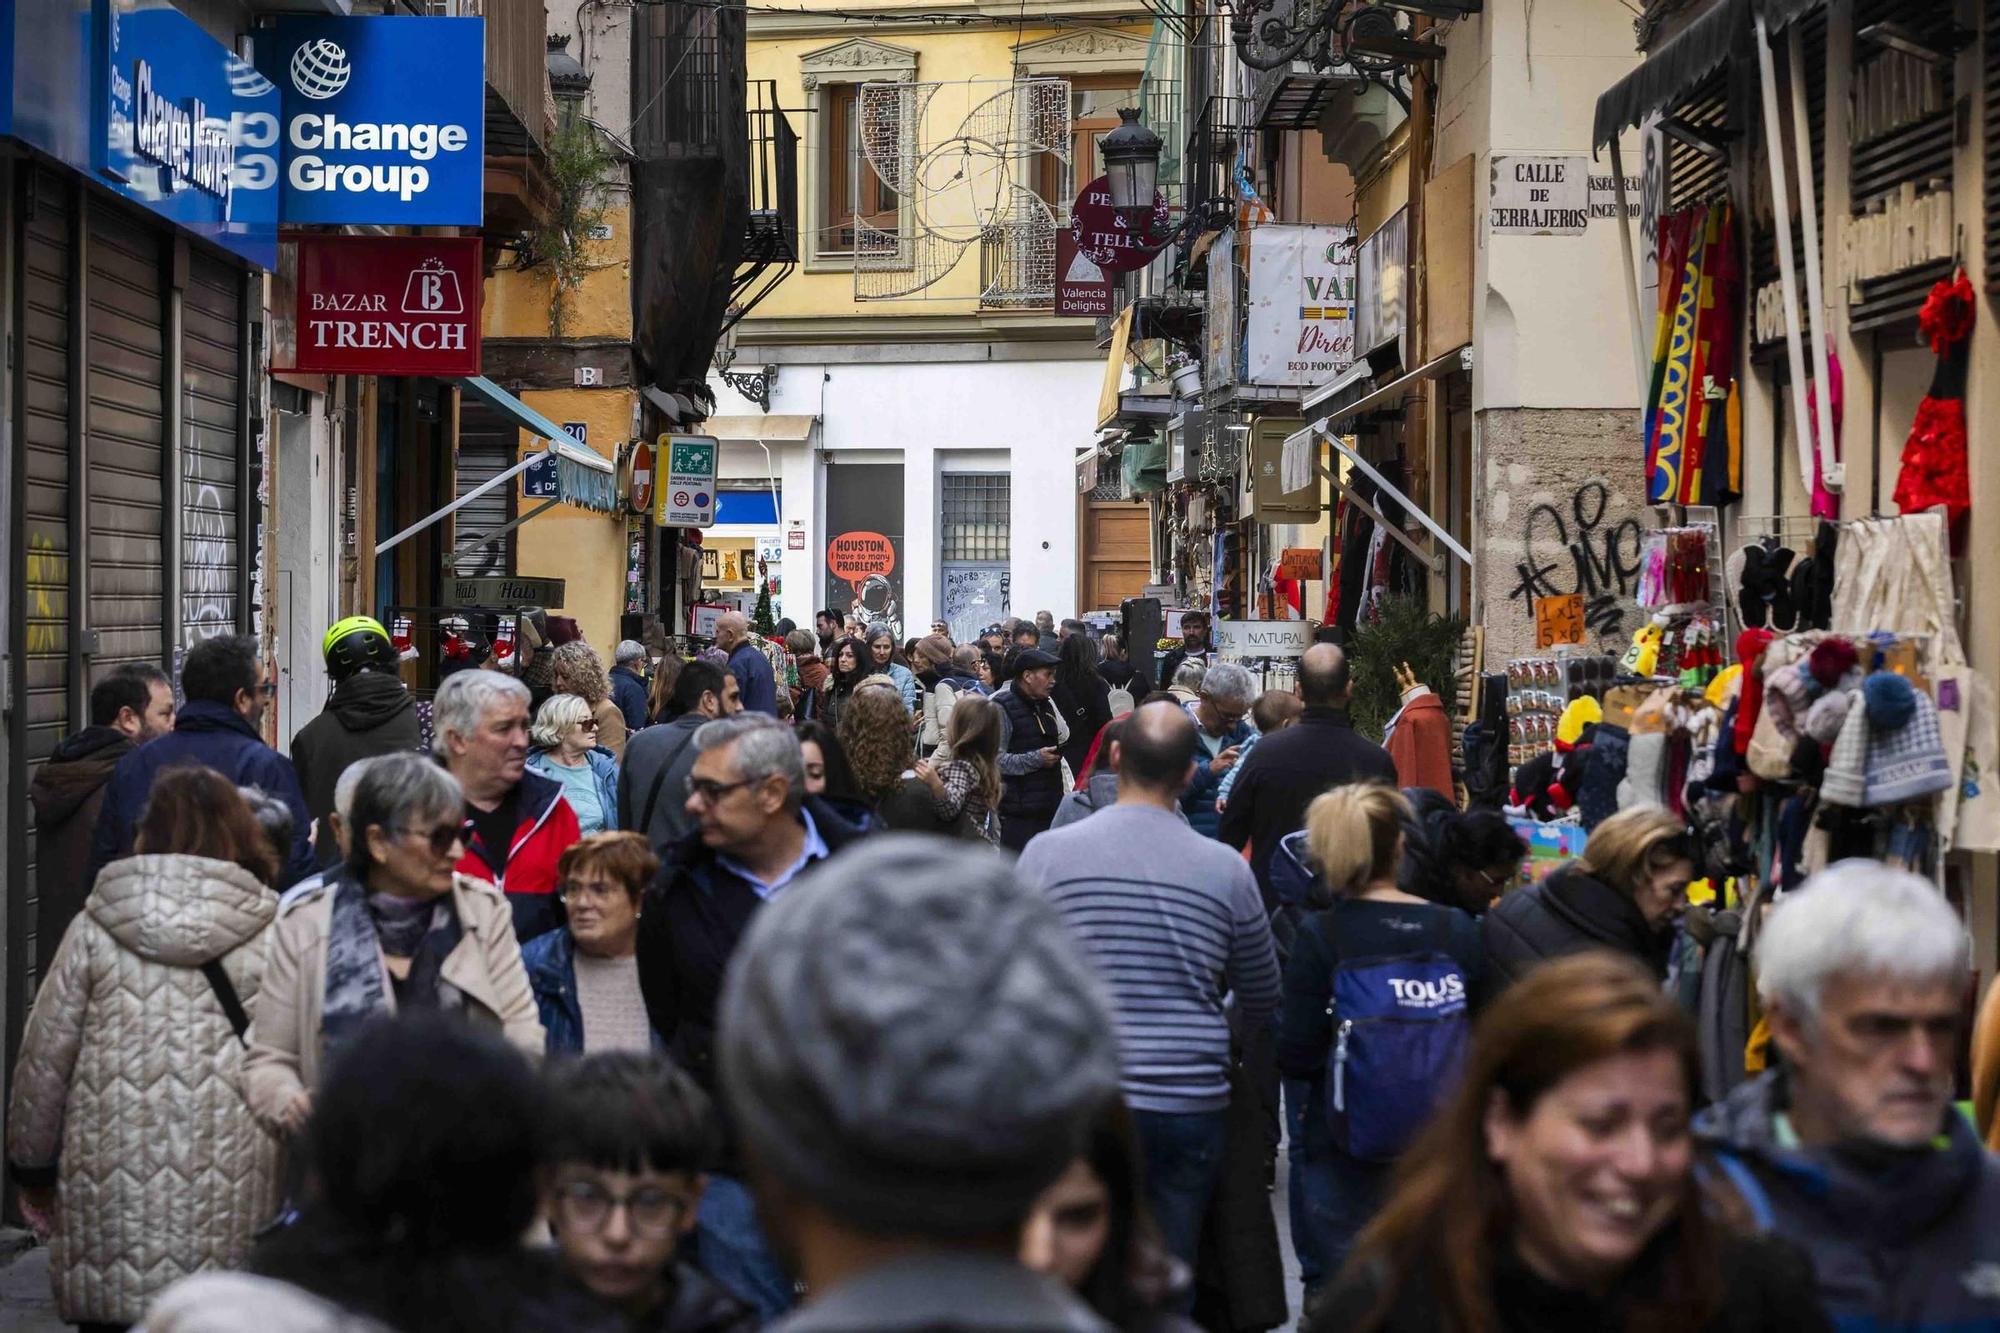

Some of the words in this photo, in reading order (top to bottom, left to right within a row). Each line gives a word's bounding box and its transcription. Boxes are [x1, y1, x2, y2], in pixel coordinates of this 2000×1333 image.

[138, 60, 190, 193] Change
[194, 98, 234, 221] Money
[289, 114, 467, 160] Change
[288, 156, 428, 200] Group
[1515, 164, 1564, 182] CALLE
[1529, 189, 1549, 202] DE
[1113, 216, 1127, 228] &
[1491, 208, 1587, 228] CERRAJEROS
[1062, 288, 1106, 298] Valencia
[311, 293, 388, 311] BAZAR
[1063, 300, 1106, 312] Delights
[310, 320, 467, 349] TRENCH
[1287, 361, 1308, 371] ECO
[836, 540, 887, 552] HOUSTON,
[836, 552, 854, 560] have
[868, 553, 890, 562] many
[1248, 632, 1304, 644] NATURAL
[1387, 973, 1464, 1001] TOUS
